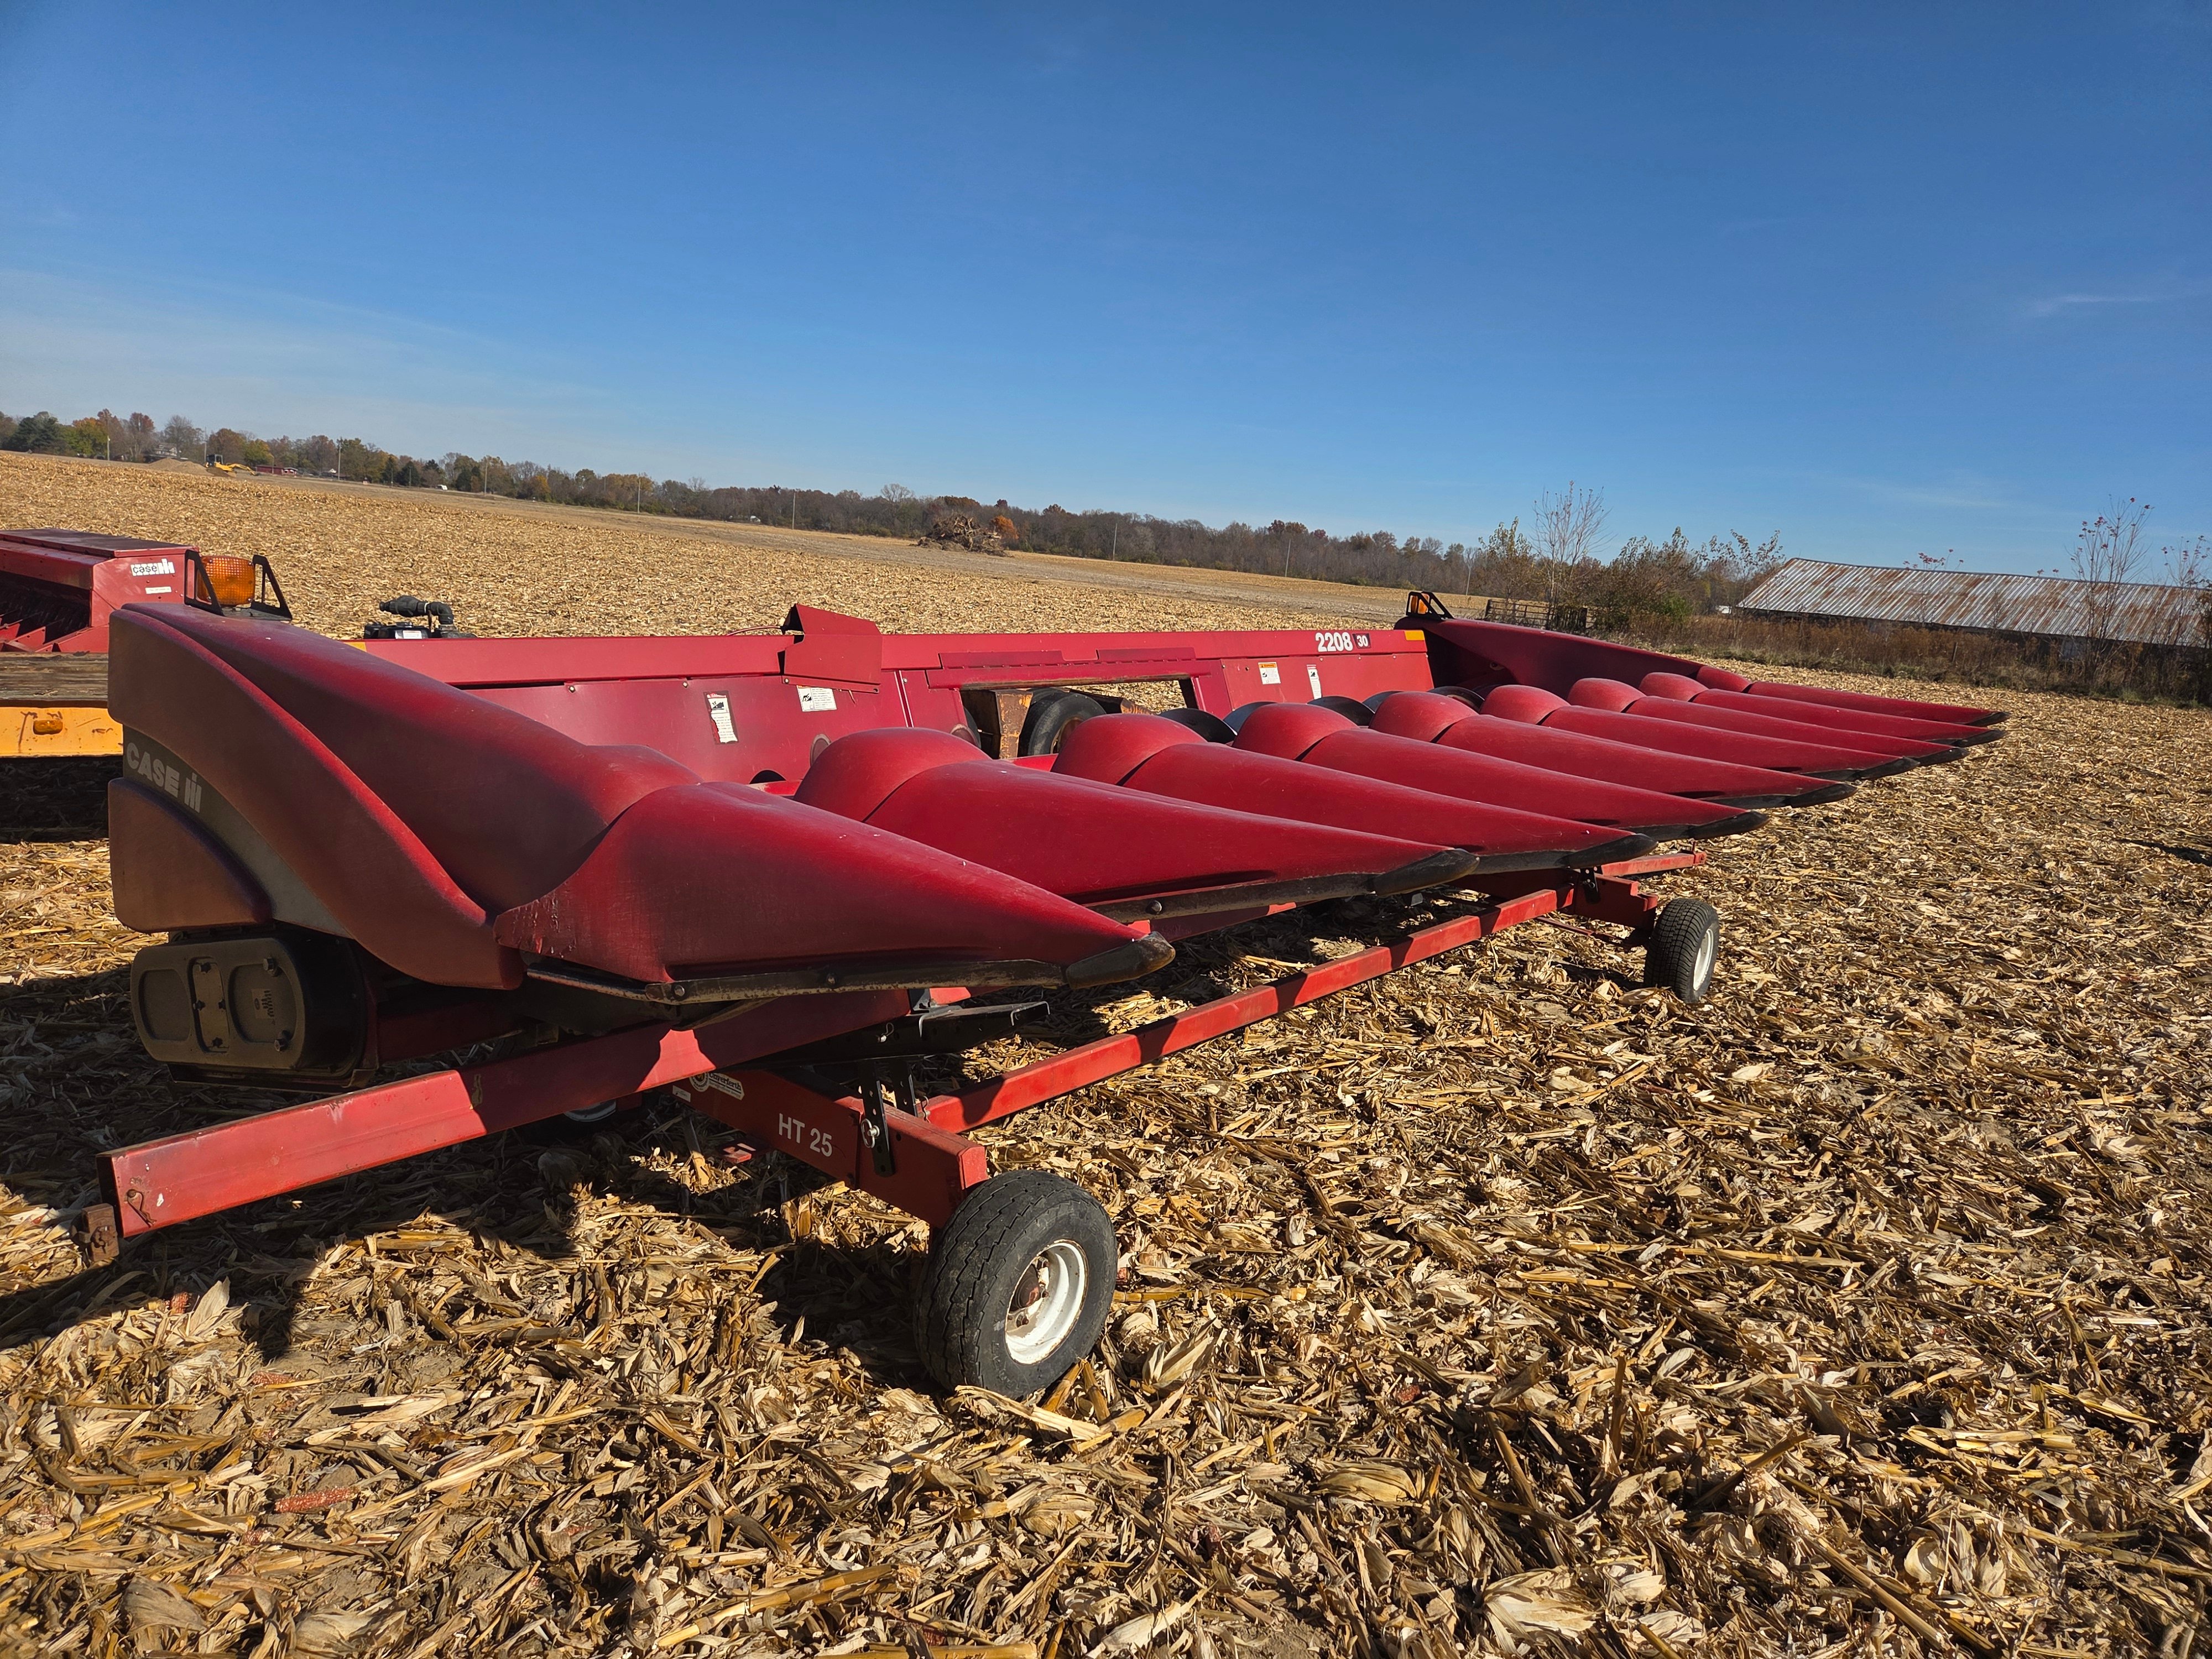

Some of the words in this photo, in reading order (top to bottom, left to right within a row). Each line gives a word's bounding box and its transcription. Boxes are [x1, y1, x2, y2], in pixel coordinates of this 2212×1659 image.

[1315, 632, 1353, 653] 2208
[1357, 635, 1369, 648] 30
[127, 743, 180, 799] CASE
[778, 1113, 805, 1144] HT
[810, 1128, 833, 1157] 25
